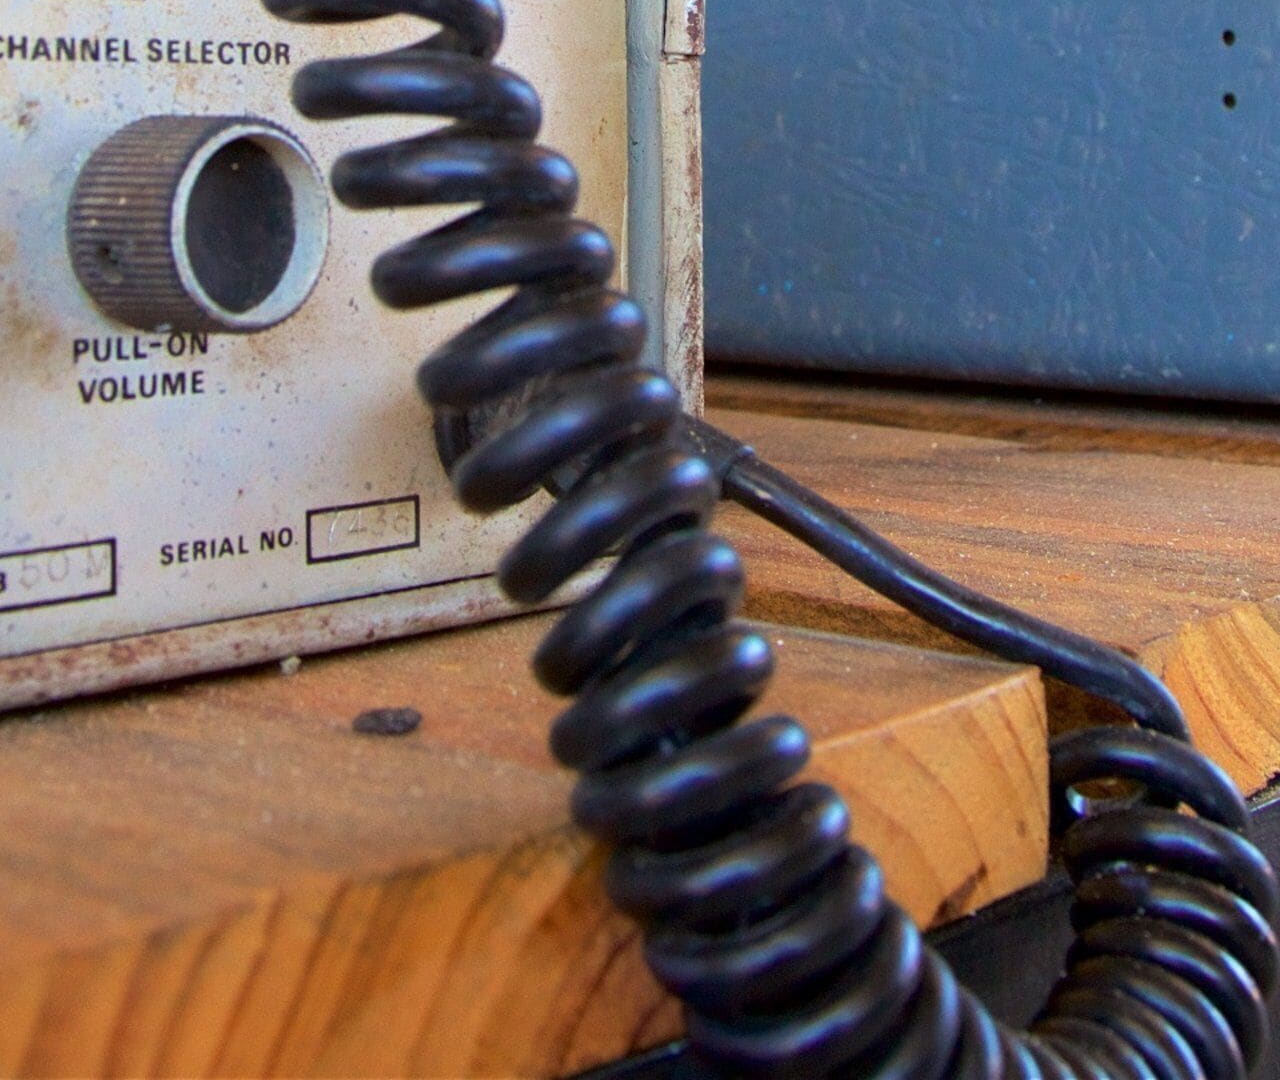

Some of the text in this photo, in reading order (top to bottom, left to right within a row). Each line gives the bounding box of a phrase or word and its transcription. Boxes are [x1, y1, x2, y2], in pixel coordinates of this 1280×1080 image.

[147, 38, 291, 66] SELECTOR
[72, 330, 209, 364] PULL-ON
[78, 370, 205, 404] VOLUME
[160, 534, 250, 566] SERIAL
